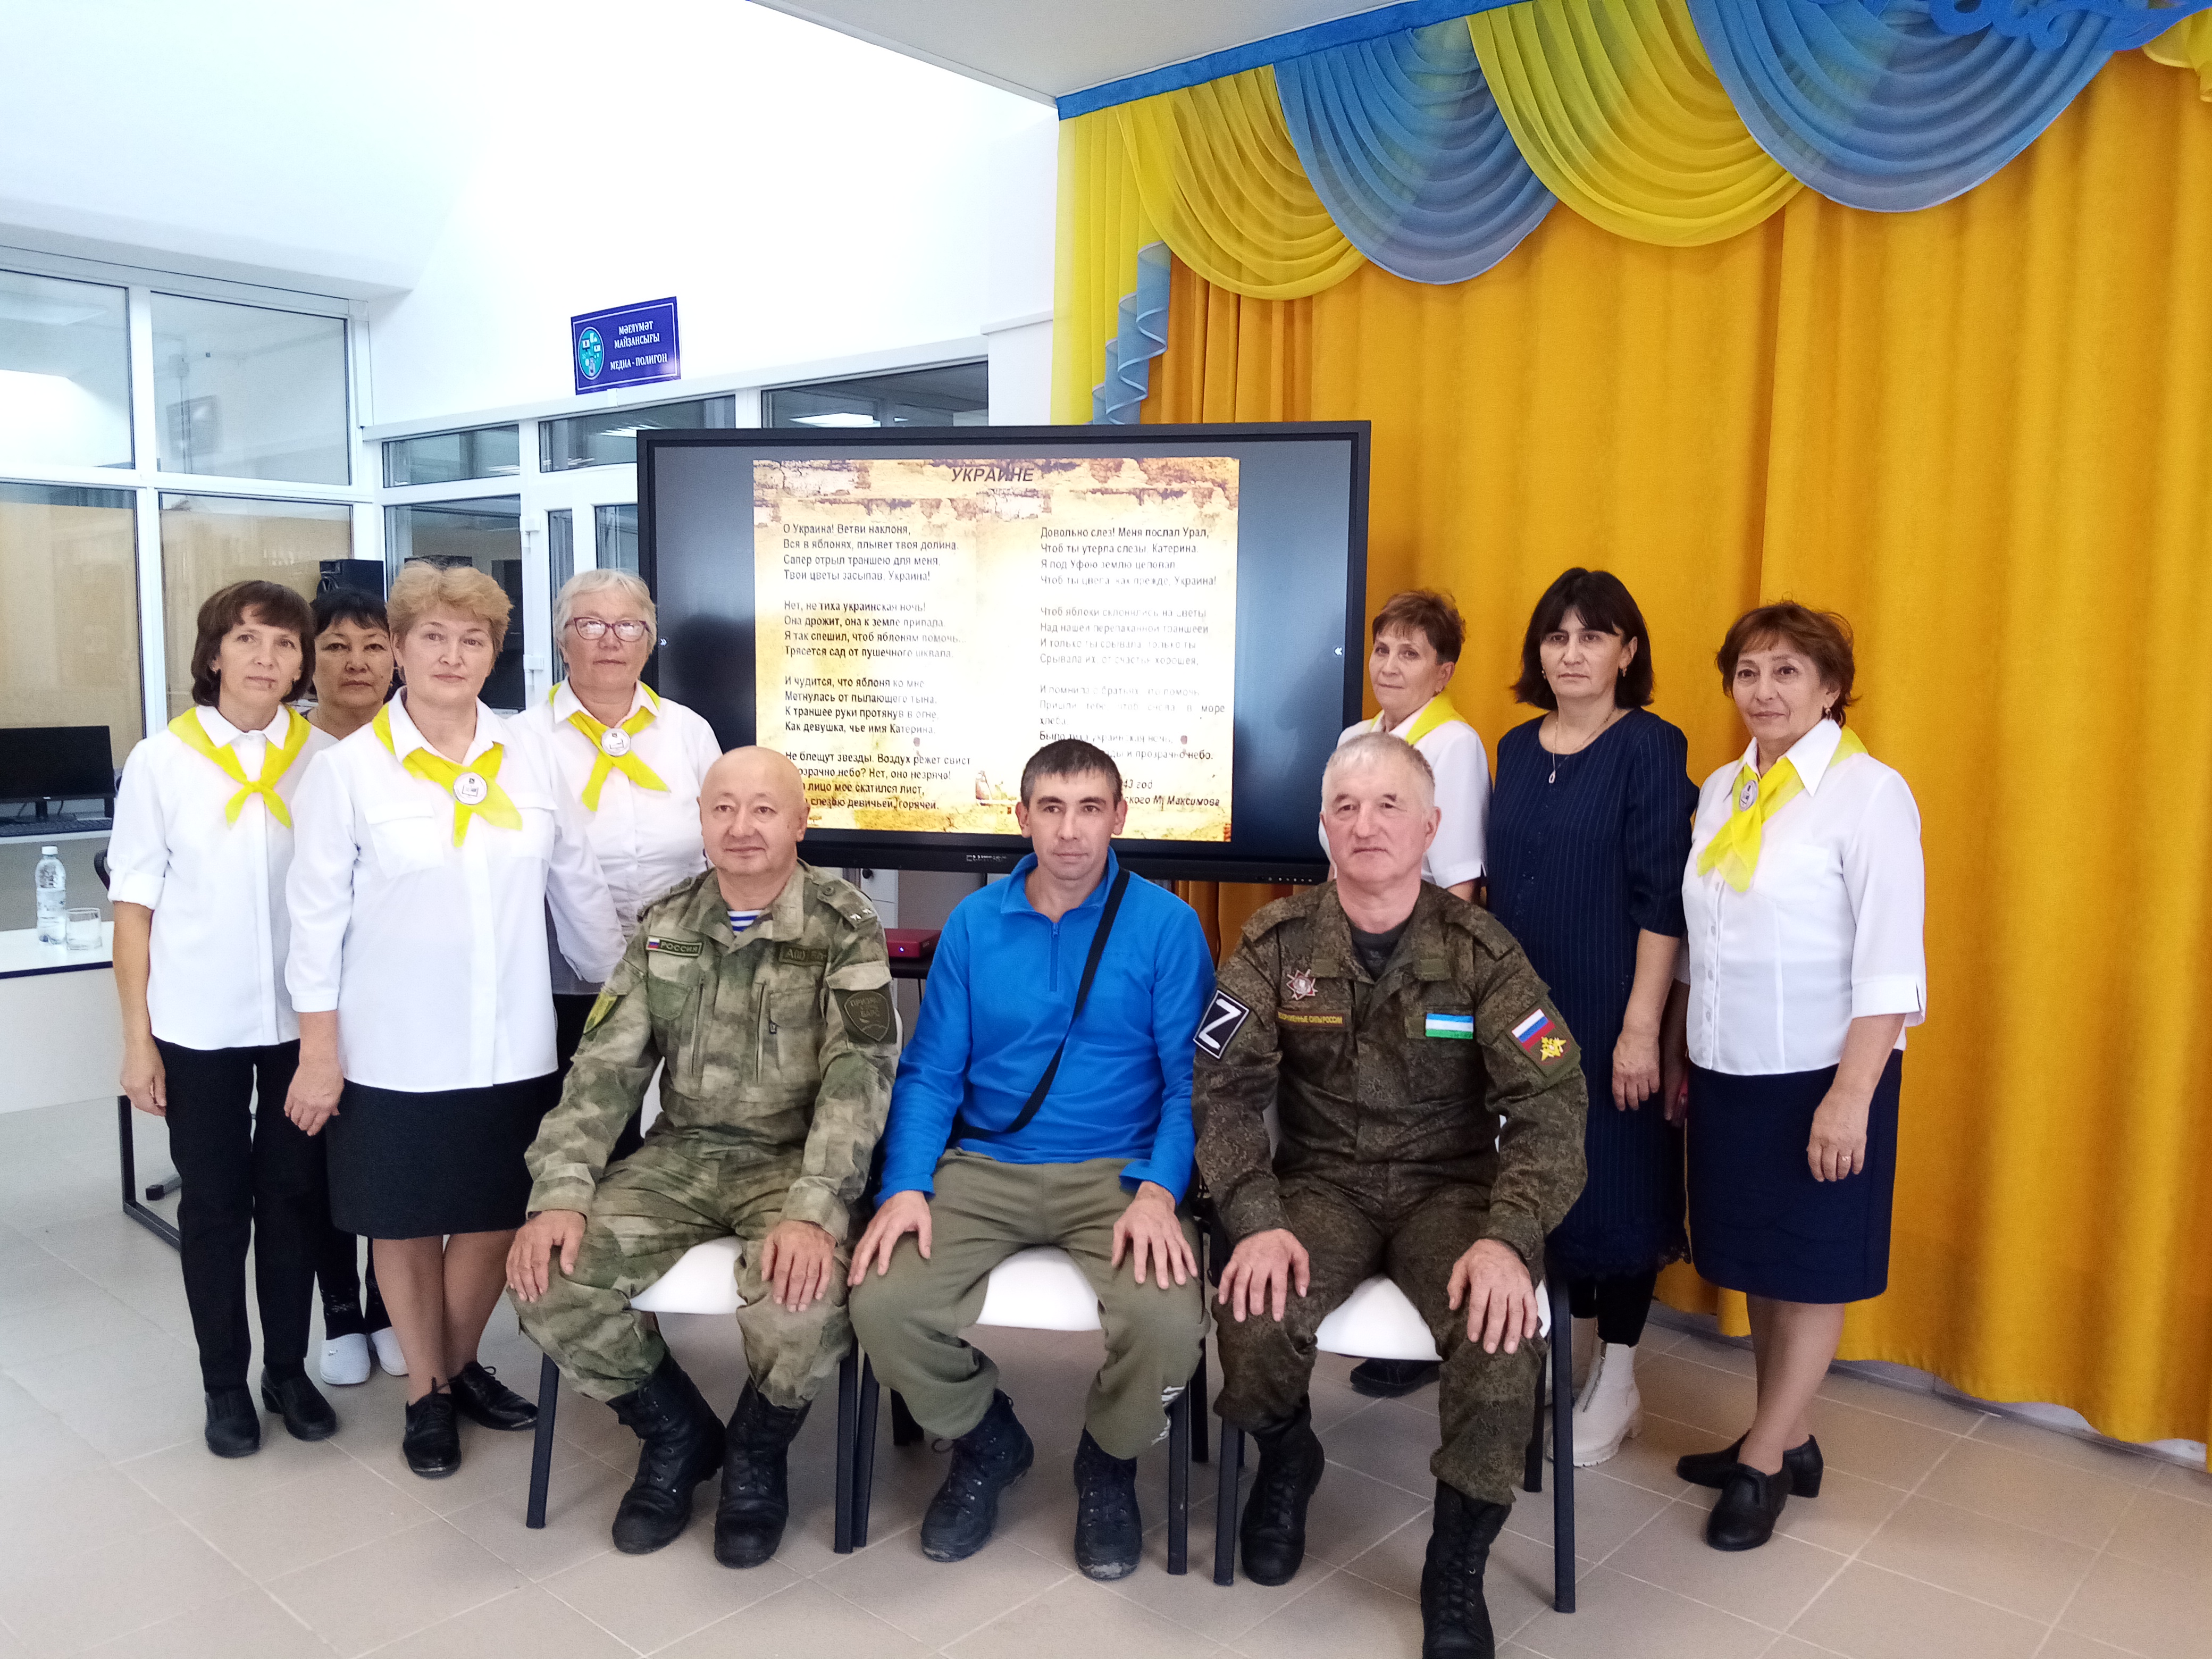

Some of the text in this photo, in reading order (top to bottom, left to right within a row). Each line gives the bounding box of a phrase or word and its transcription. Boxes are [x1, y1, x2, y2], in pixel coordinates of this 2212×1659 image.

[610, 358, 632, 371] МЕДИА
[635, 353, 668, 366] ПОЛИГОН
[951, 467, 1034, 482] УКРАИНЕ
[783, 523, 911, 537] О Украина! Ветви наклоня,
[1040, 526, 1209, 540] Довольно слез! Меня послал Урал,
[783, 538, 800, 549] Вся
[803, 540, 809, 549] в
[812, 539, 854, 552] яблонях,
[857, 541, 893, 549] плывет
[895, 541, 918, 550] твоя
[1041, 543, 1063, 554] Чтоб
[1066, 545, 1079, 554] ты
[1082, 545, 1115, 556] утерла
[1152, 543, 1199, 556] Катерина.
[783, 555, 812, 568] Сапер
[815, 557, 845, 568] отрыл
[848, 557, 891, 568] траншею
[893, 557, 911, 567] для
[1041, 558, 1132, 572] Я под Уфою землю
[784, 569, 807, 580] Твои
[810, 572, 840, 582] цветы
[888, 571, 931, 584] Украина!
[1041, 574, 1063, 585] Чтоб
[1067, 576, 1079, 585] ты
[1174, 575, 1216, 588] Украина!
[784, 600, 926, 614] Нет, не тиха украинская ночь!
[1041, 606, 1063, 617] Чтоб
[1162, 609, 1173, 617] на
[784, 615, 802, 626] Она
[805, 618, 842, 629] дрожит,
[844, 618, 861, 627] она
[864, 618, 869, 627] к
[872, 618, 900, 627] земле
[1040, 621, 1058, 633] Над
[784, 630, 791, 641] Я
[793, 632, 809, 641] так
[810, 633, 850, 644] спешил,
[852, 631, 874, 642] чтоб
[877, 632, 919, 642] яблоням
[1040, 637, 1046, 648] И
[1050, 639, 1082, 648] только
[1184, 641, 1196, 649] ты
[785, 645, 954, 659] Трясется сад от пушечного шквала.
[1040, 653, 1082, 666] Срывала
[1102, 656, 1111, 664] от
[785, 675, 925, 689] И чудится, что яблоня ко мне
[1040, 683, 1046, 694] И
[1163, 688, 1200, 696] помочь
[785, 691, 937, 705] Метнулась от пылающего тына.
[785, 706, 791, 716] К
[793, 708, 833, 719] траншее
[835, 709, 857, 720] руки
[859, 709, 904, 720] протянув
[907, 710, 912, 718] в
[1040, 699, 1077, 713] Пришли
[1201, 704, 1225, 715] море
[785, 721, 936, 736] Как девушка, чье имя Катерина.
[799, 750, 834, 764] блещут
[837, 753, 874, 764] звезды.
[877, 752, 910, 766] Воздух
[913, 756, 941, 767] режет
[944, 756, 970, 765] свист
[1127, 750, 1132, 758] и
[1135, 750, 1185, 761] прозрачно
[1188, 749, 1213, 760] небо.
[798, 768, 835, 779] озрачно
[837, 767, 866, 777] небо?
[869, 767, 888, 781] Нет,
[890, 769, 907, 778] оно
[808, 783, 832, 793] лицо
[854, 784, 898, 793] скатился
[900, 785, 925, 797] лист,
[1136, 780, 1153, 790] год
[1167, 795, 1220, 807] Максимова
[660, 941, 698, 952] РОССИЯ
[1198, 998, 1242, 1051] Z
